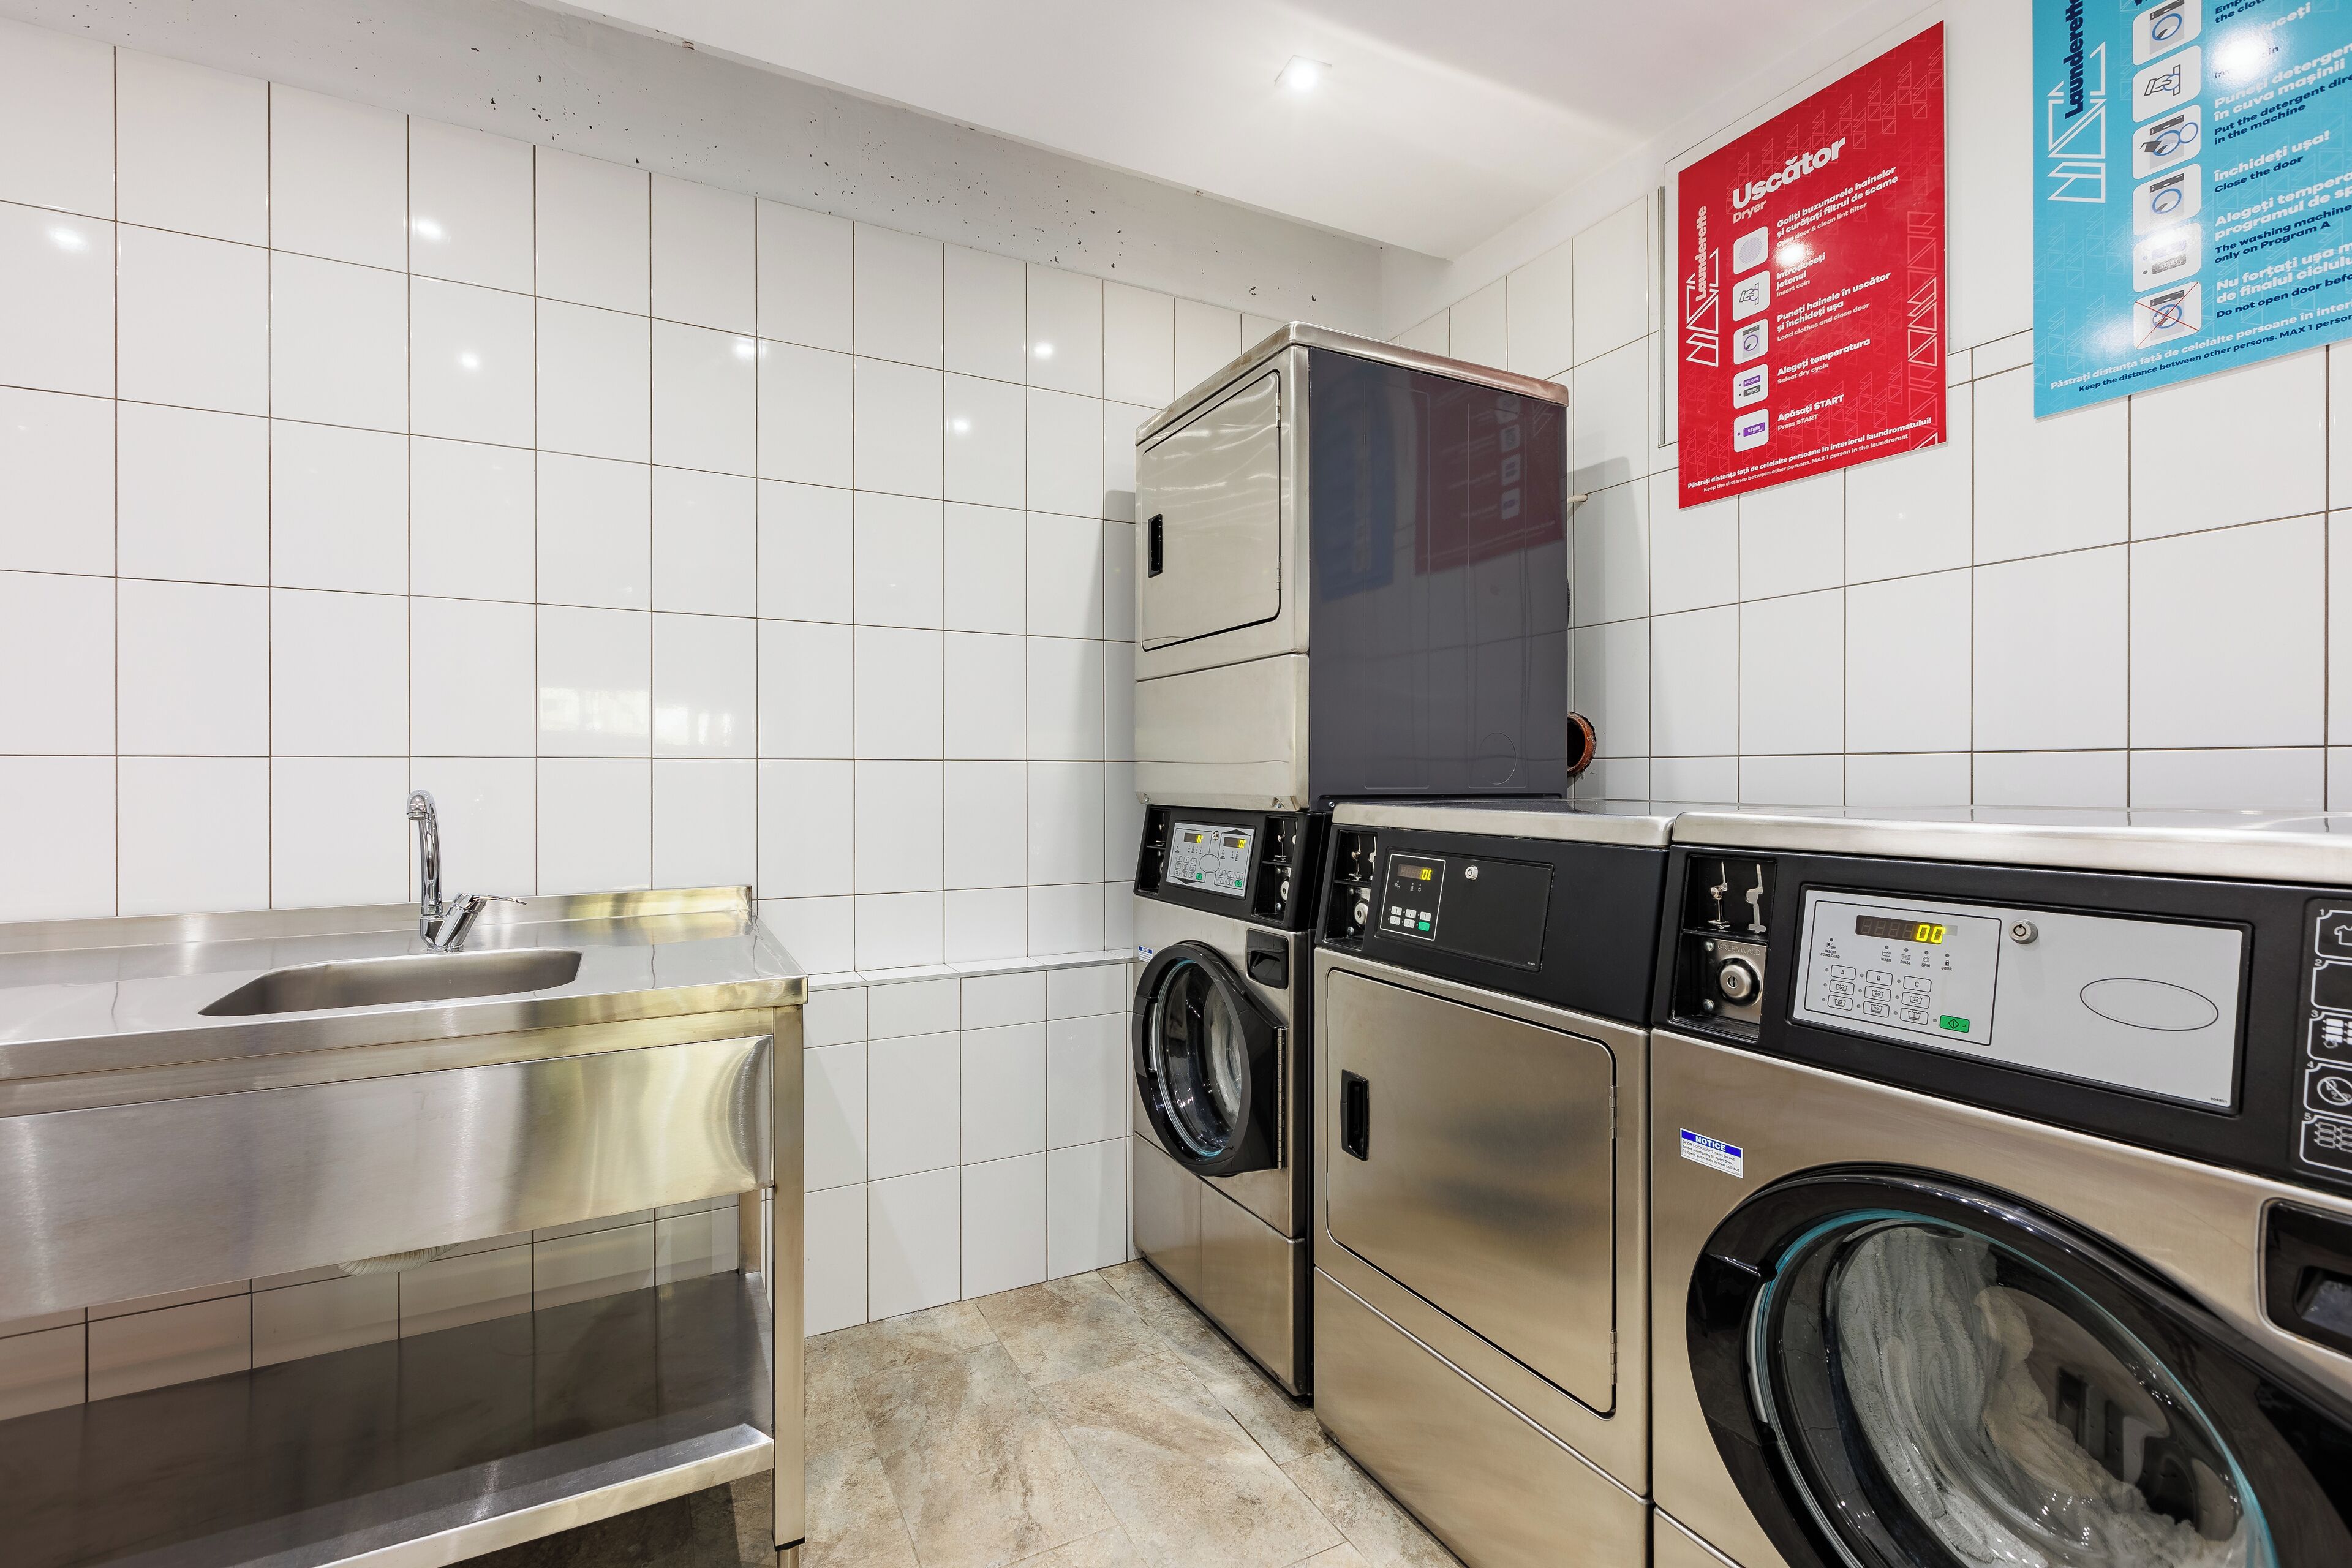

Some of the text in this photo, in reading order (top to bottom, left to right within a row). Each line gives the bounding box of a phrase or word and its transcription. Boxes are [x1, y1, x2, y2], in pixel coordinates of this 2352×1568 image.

[2215, 11, 2235, 23] the
[2214, 110, 2230, 121] în
[2233, 91, 2274, 113] cuva
[2278, 58, 2345, 95] mașinii
[2214, 85, 2326, 135] Put the detergent
[2214, 104, 2306, 145] in the machine
[1733, 137, 1845, 209] Uscător
[2214, 130, 2330, 182] Închideți ușa!
[2214, 156, 2304, 193] Close the door
[1733, 200, 1766, 224] Dryer
[1776, 228, 1784, 239] și
[1823, 197, 1849, 215] filtrul
[1851, 192, 1863, 202] de
[1864, 176, 1898, 196] scame
[1777, 167, 1896, 227] Goliți buzunarele hainelor
[2215, 197, 2274, 227] Alegeți
[1795, 229, 1811, 239] door
[1817, 216, 1836, 229] clean
[1837, 211, 1849, 221] lint
[1850, 203, 1867, 214] filter
[2215, 194, 2331, 241] programul de
[2215, 204, 2352, 254] The washing machine
[1695, 206, 1707, 301] Launderette
[2215, 221, 2331, 263] only on Program A
[1776, 271, 1807, 292] jetonul
[1776, 279, 1810, 297] Insert coin
[2217, 248, 2334, 291] Nu forțați ușa
[2217, 272, 2293, 304] de finalul
[1777, 273, 1891, 322] Puneți hainele în uscător
[1777, 301, 1844, 333] și închideți ușa
[2217, 283, 2323, 318] Do not open door
[1777, 303, 1870, 342] Load clothes and close door
[1777, 338, 1871, 376] Alegeți temperatura
[2050, 312, 2313, 390] Păstrați distanța față de celelalte persoane în
[2079, 382, 2101, 392] Keep
[2102, 377, 2118, 386] the
[2119, 367, 2157, 382] distance
[2159, 355, 2201, 370] between
[2204, 345, 2231, 358] other
[2233, 336, 2277, 352] persons.
[2280, 326, 2306, 338] MAX
[1777, 363, 1829, 385] Select dry cycle
[1777, 394, 1845, 422] Apăsați START
[1777, 414, 1819, 431] Press START
[1687, 477, 1711, 489] Păstrați
[1759, 457, 1787, 469] celelalte
[1789, 449, 1820, 462] persoane
[1830, 435, 1865, 450] interiorul
[1866, 417, 1932, 441] laundromatului!
[1726, 478, 1747, 487] distance
[1748, 471, 1771, 480] between
[1787, 461, 1811, 471] persons.
[1830, 450, 1850, 459] person
[1870, 434, 1909, 448] laundromat
[1717, 943, 1761, 956] GREENWALD
[1695, 1136, 1725, 1152] NOTICE
